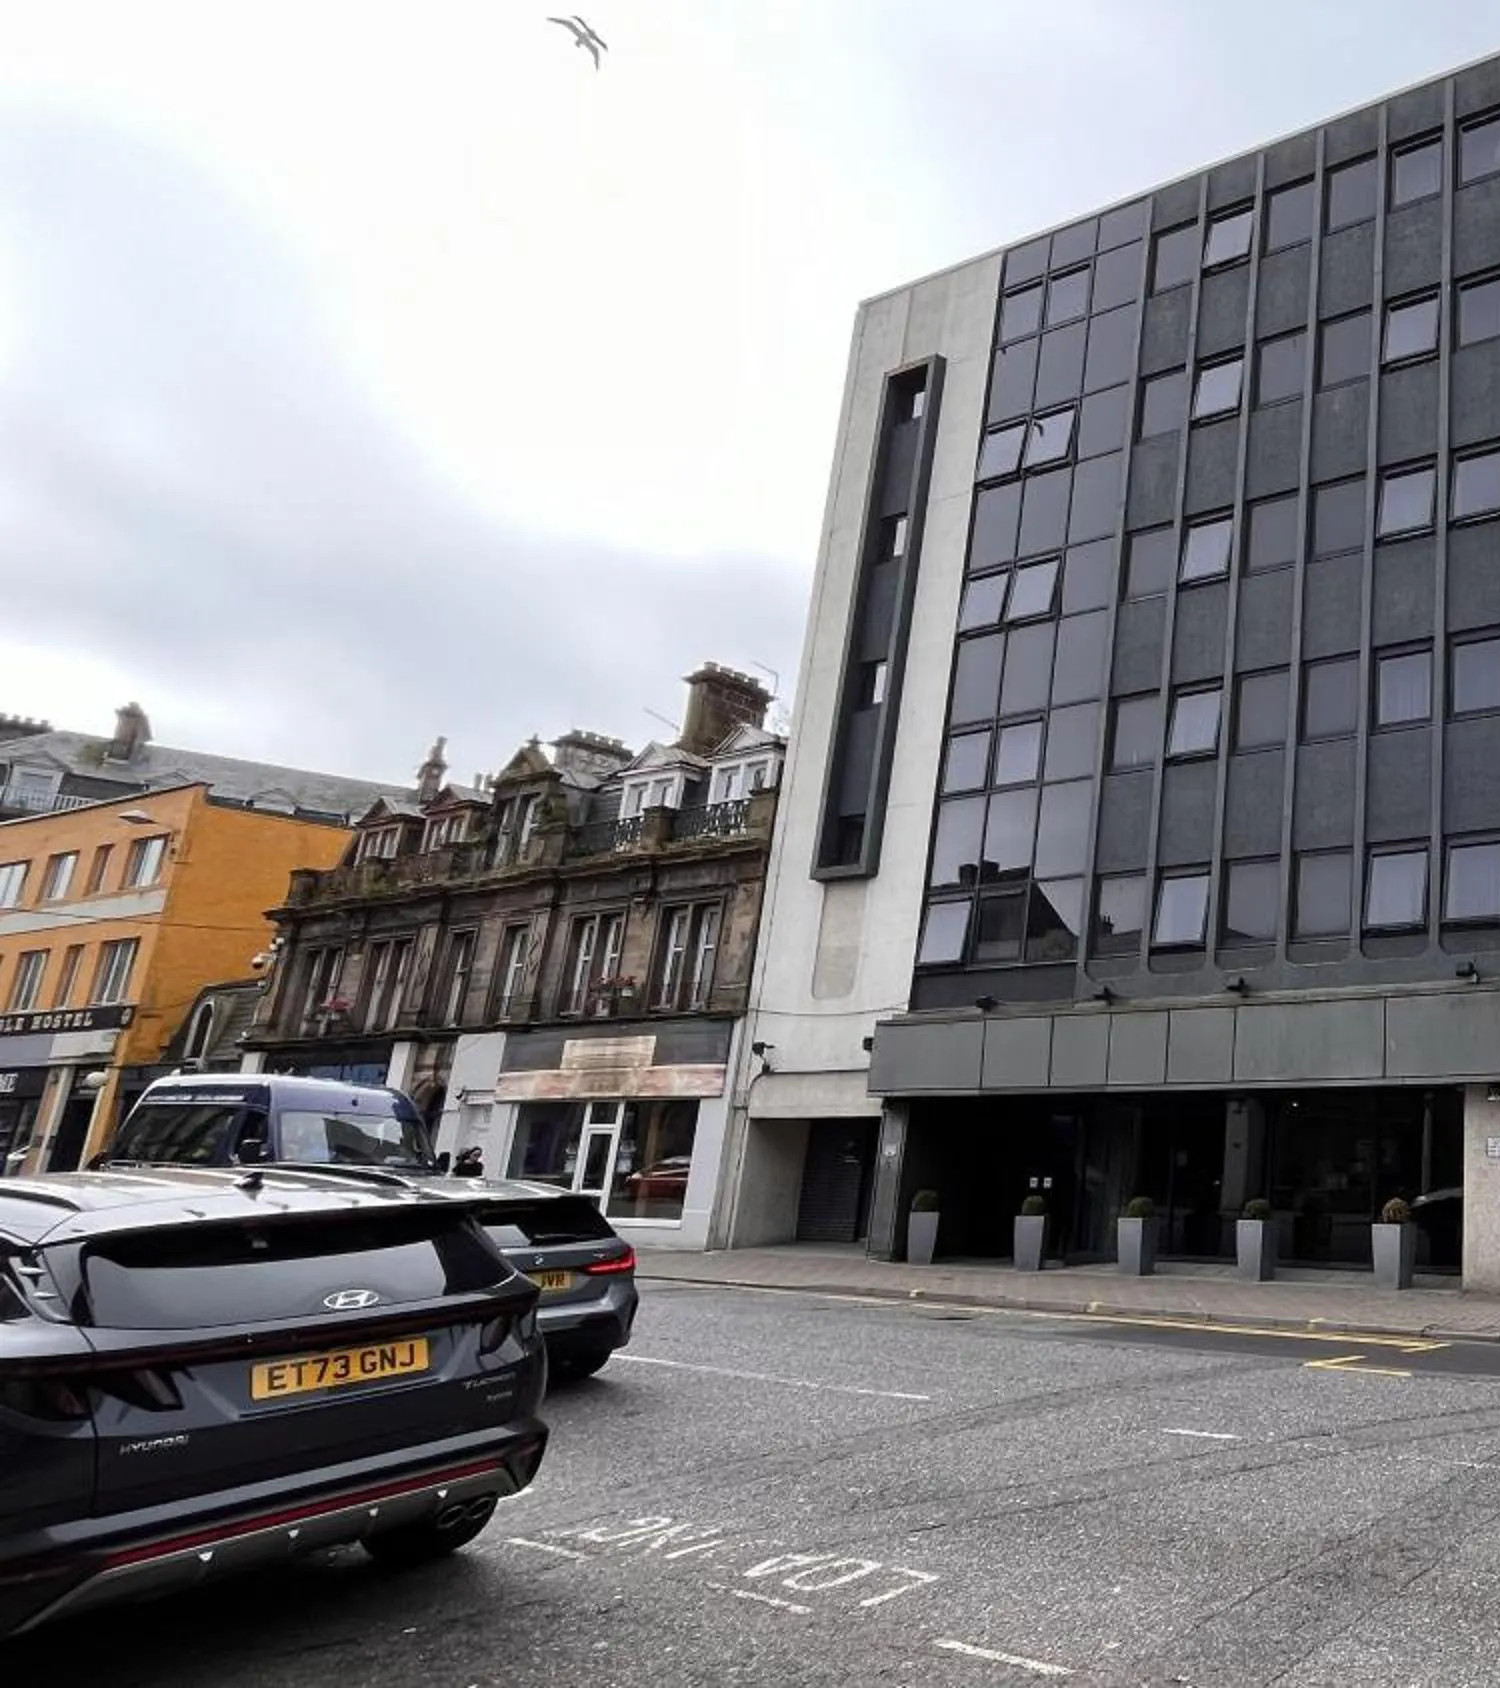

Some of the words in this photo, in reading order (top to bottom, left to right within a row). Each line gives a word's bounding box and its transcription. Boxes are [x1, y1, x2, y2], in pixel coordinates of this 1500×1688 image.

[31, 1012, 93, 1030] HOSTEL
[267, 1355, 350, 1391] ET73
[360, 1343, 415, 1375] GNJ
